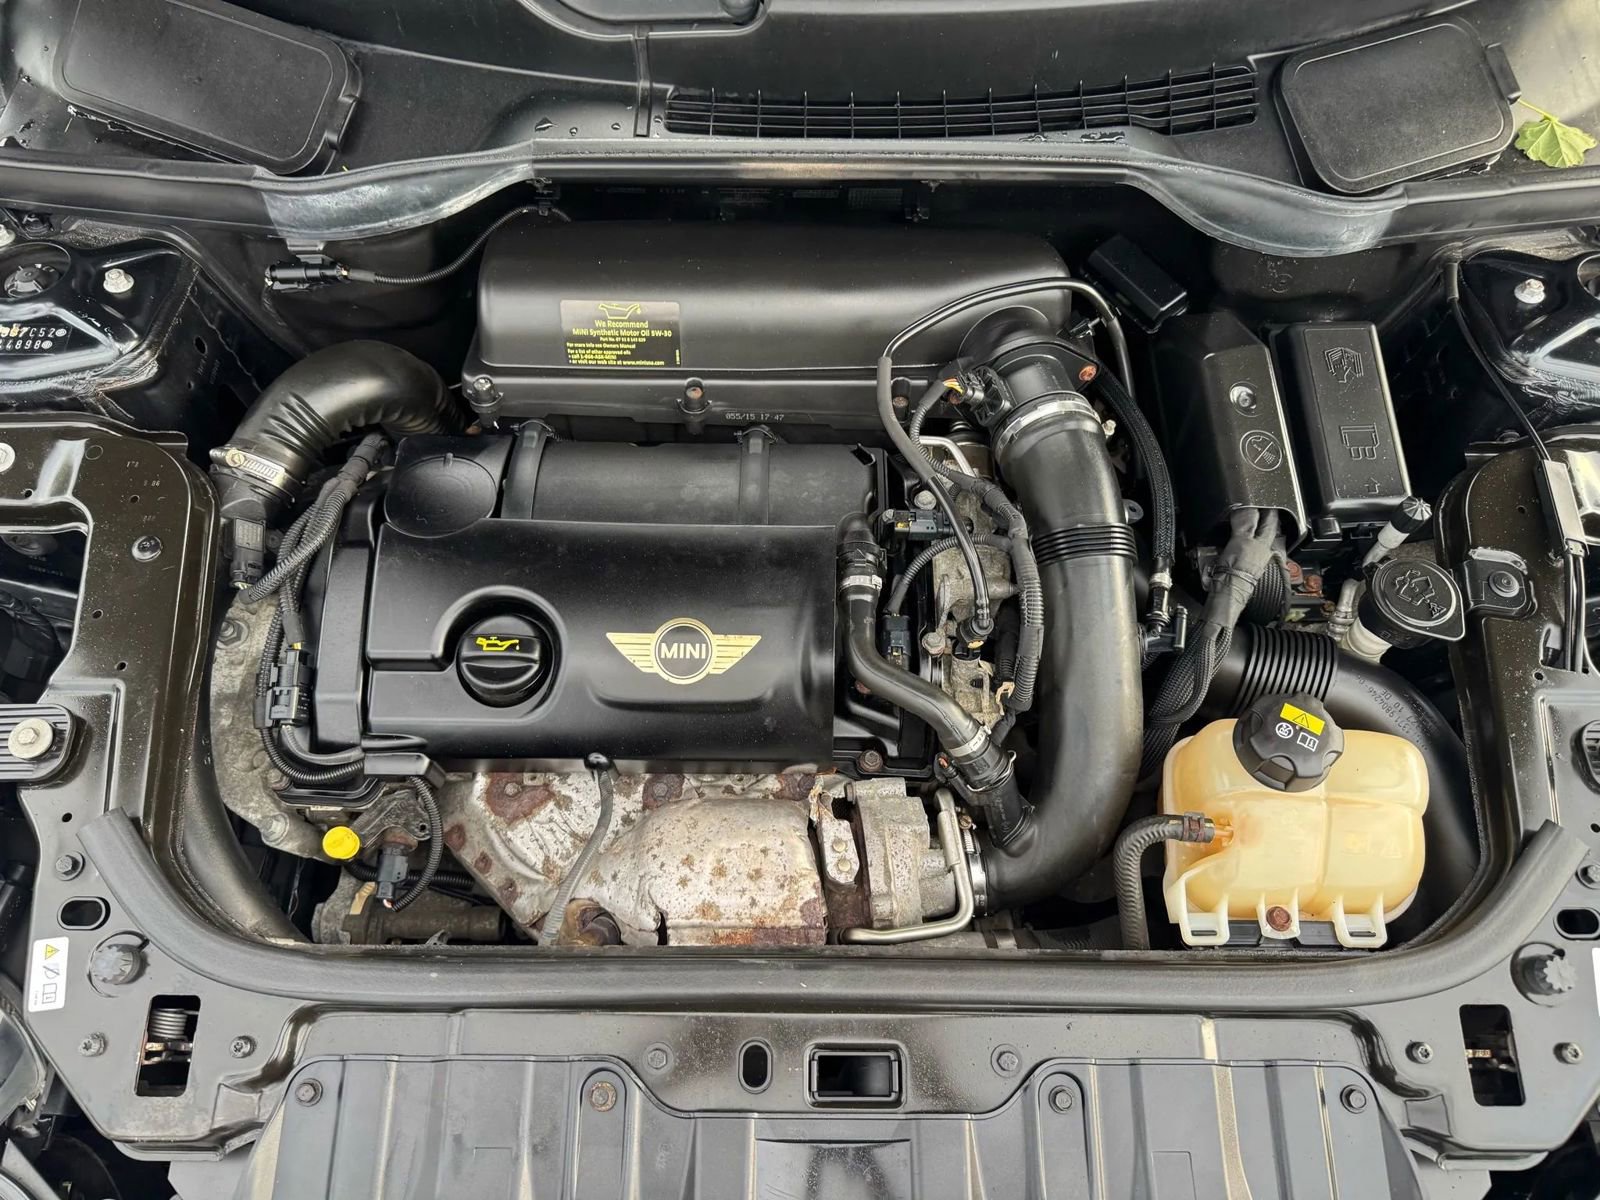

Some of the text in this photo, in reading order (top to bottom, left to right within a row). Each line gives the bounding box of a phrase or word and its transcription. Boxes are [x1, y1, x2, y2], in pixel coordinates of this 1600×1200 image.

[607, 320, 648, 328] Recommend
[590, 328, 619, 337] Synthetic
[660, 642, 706, 659] MINI
